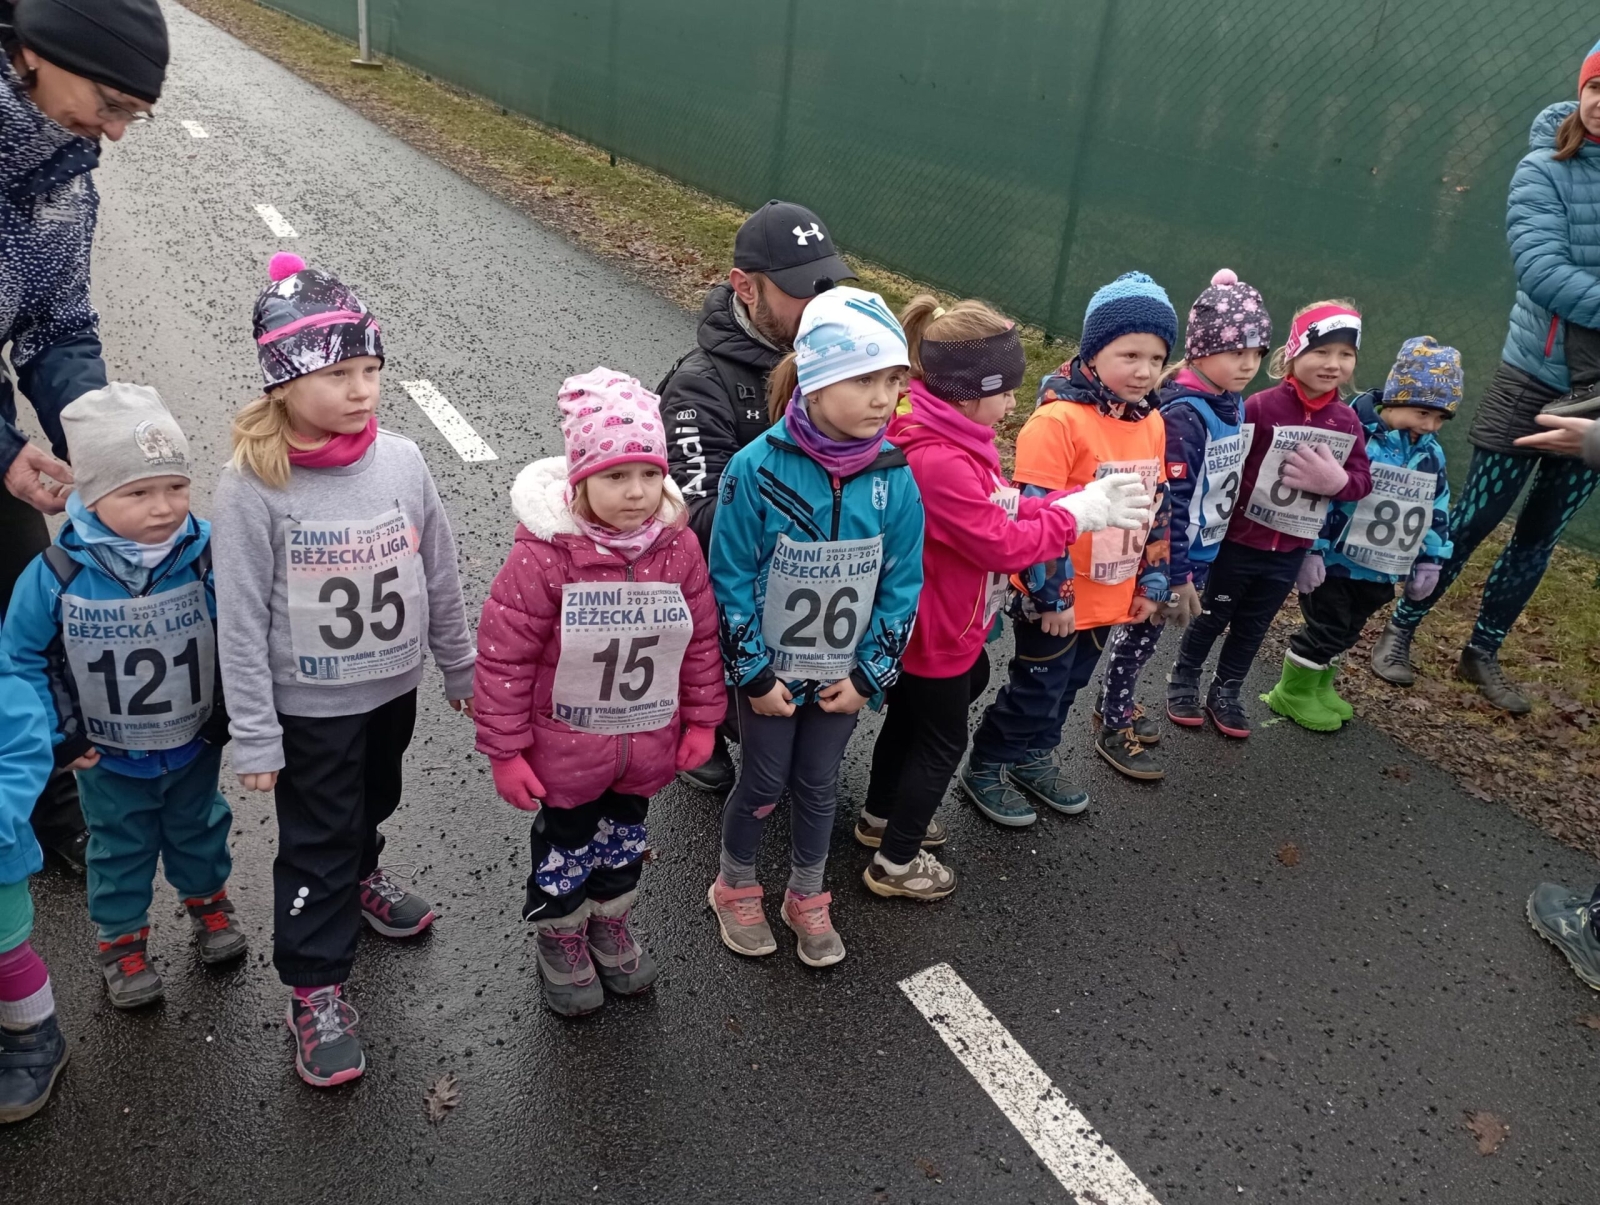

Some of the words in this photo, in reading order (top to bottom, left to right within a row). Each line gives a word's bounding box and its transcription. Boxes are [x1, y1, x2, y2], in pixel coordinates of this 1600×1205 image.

[1278, 430, 1313, 442] ZIMNÍ
[1208, 438, 1240, 458] ZIMNÍ
[675, 426, 707, 497] Audi
[1371, 468, 1410, 484] ZIMNÍ
[1366, 500, 1426, 552] 89
[290, 528, 350, 546] ZIMNÍ
[290, 545, 376, 564] BĚŽECKÁ
[381, 535, 408, 558] LIGA
[776, 542, 822, 562] ZIMNÍ
[772, 556, 840, 578] BĚŽECKÁ
[848, 559, 877, 576] LIGA
[566, 588, 622, 606] ZIMNÍ
[69, 604, 125, 622] ZIMNÍ
[134, 596, 200, 620] 2023-2024
[318, 566, 405, 650] 35
[566, 607, 646, 626] BĚŽECKÁ
[654, 607, 688, 624] LIGA
[780, 586, 859, 649] 26
[68, 620, 157, 639] BĚŽECKÁ
[166, 609, 204, 632] LIGA
[342, 650, 376, 662] VYRÁBÍME
[378, 642, 408, 658] STARTOVNÍ
[87, 637, 202, 716] 121
[592, 635, 660, 702] 15
[594, 706, 626, 715] VYRÁBÍME
[628, 700, 658, 713] STARTOVNÍ
